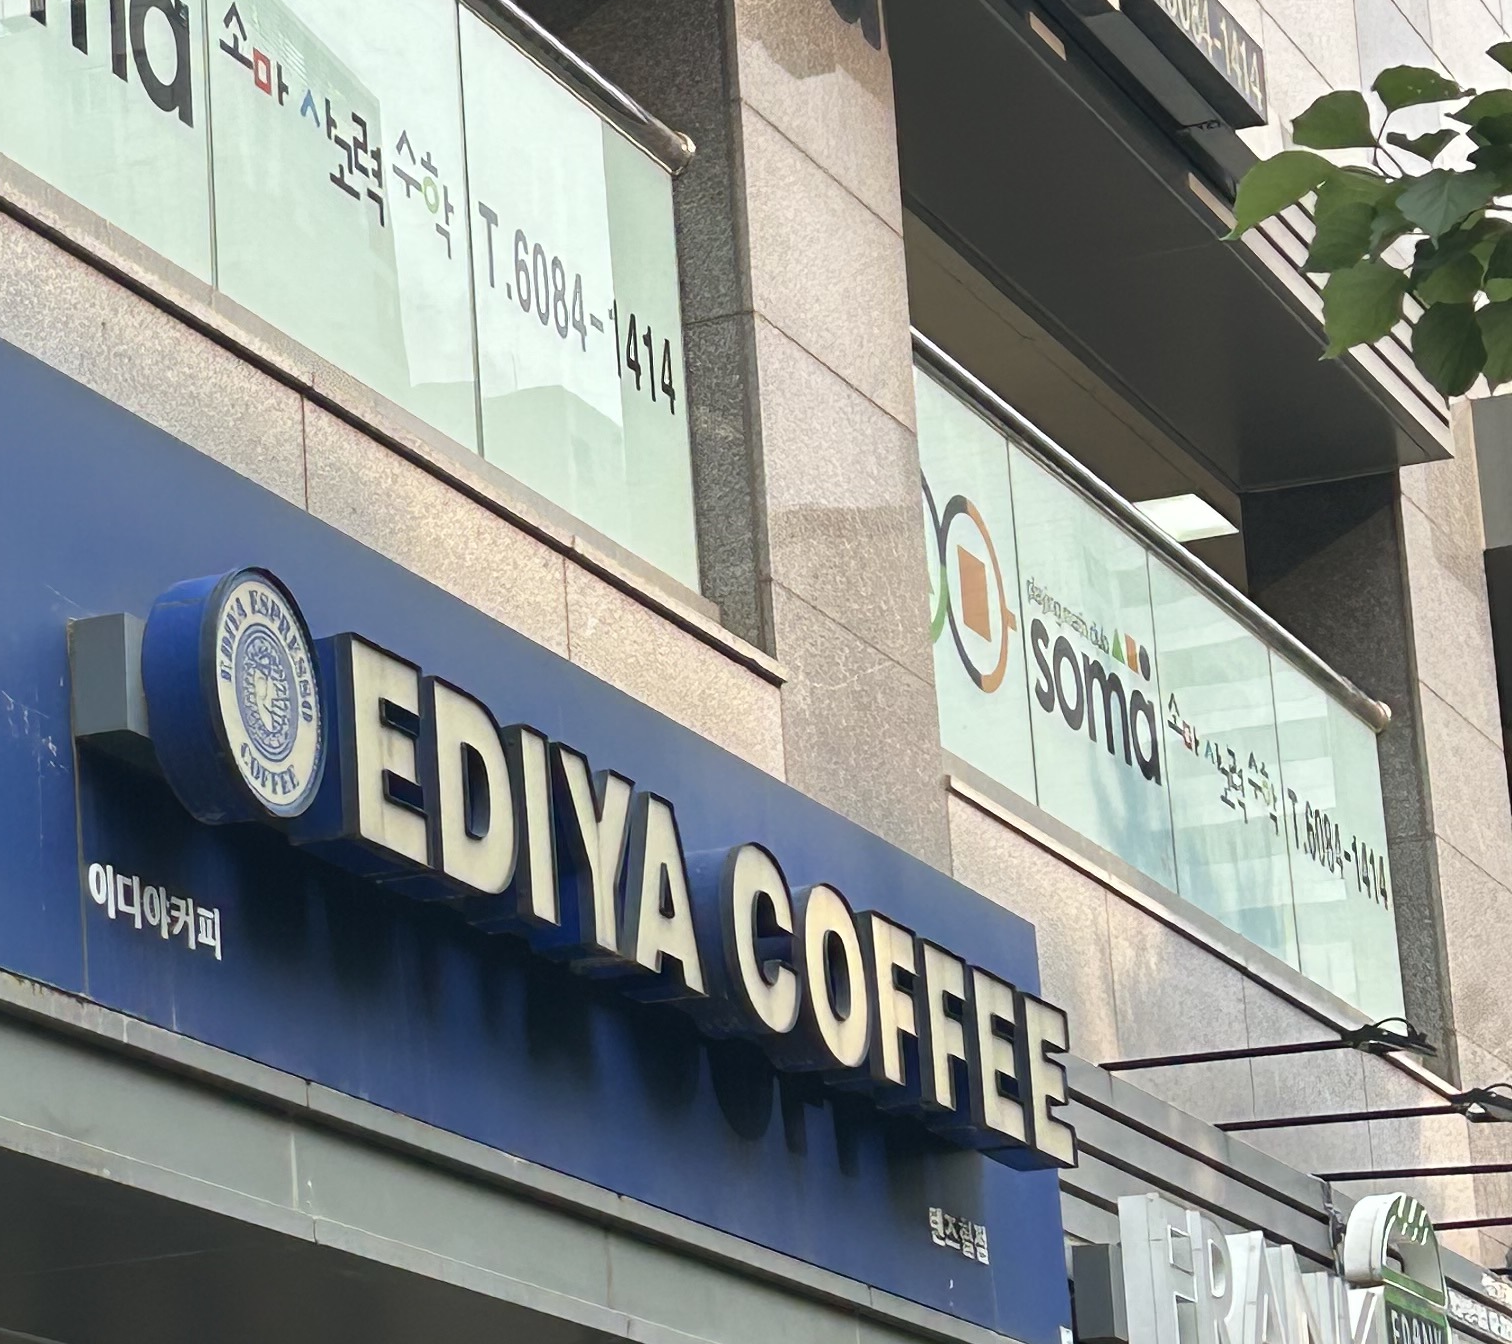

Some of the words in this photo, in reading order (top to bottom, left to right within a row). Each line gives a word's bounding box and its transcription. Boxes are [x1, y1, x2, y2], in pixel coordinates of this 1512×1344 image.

[477, 199, 677, 417] T.6084-1414
[240, 742, 300, 796] COFFEE
[1029, 617, 1163, 787] soma
[88, 862, 223, 962] 이디야커피
[344, 632, 706, 997] EDIYA
[730, 842, 1078, 1169] COFFEE
[1287, 786, 1390, 912] T.6084-1414
